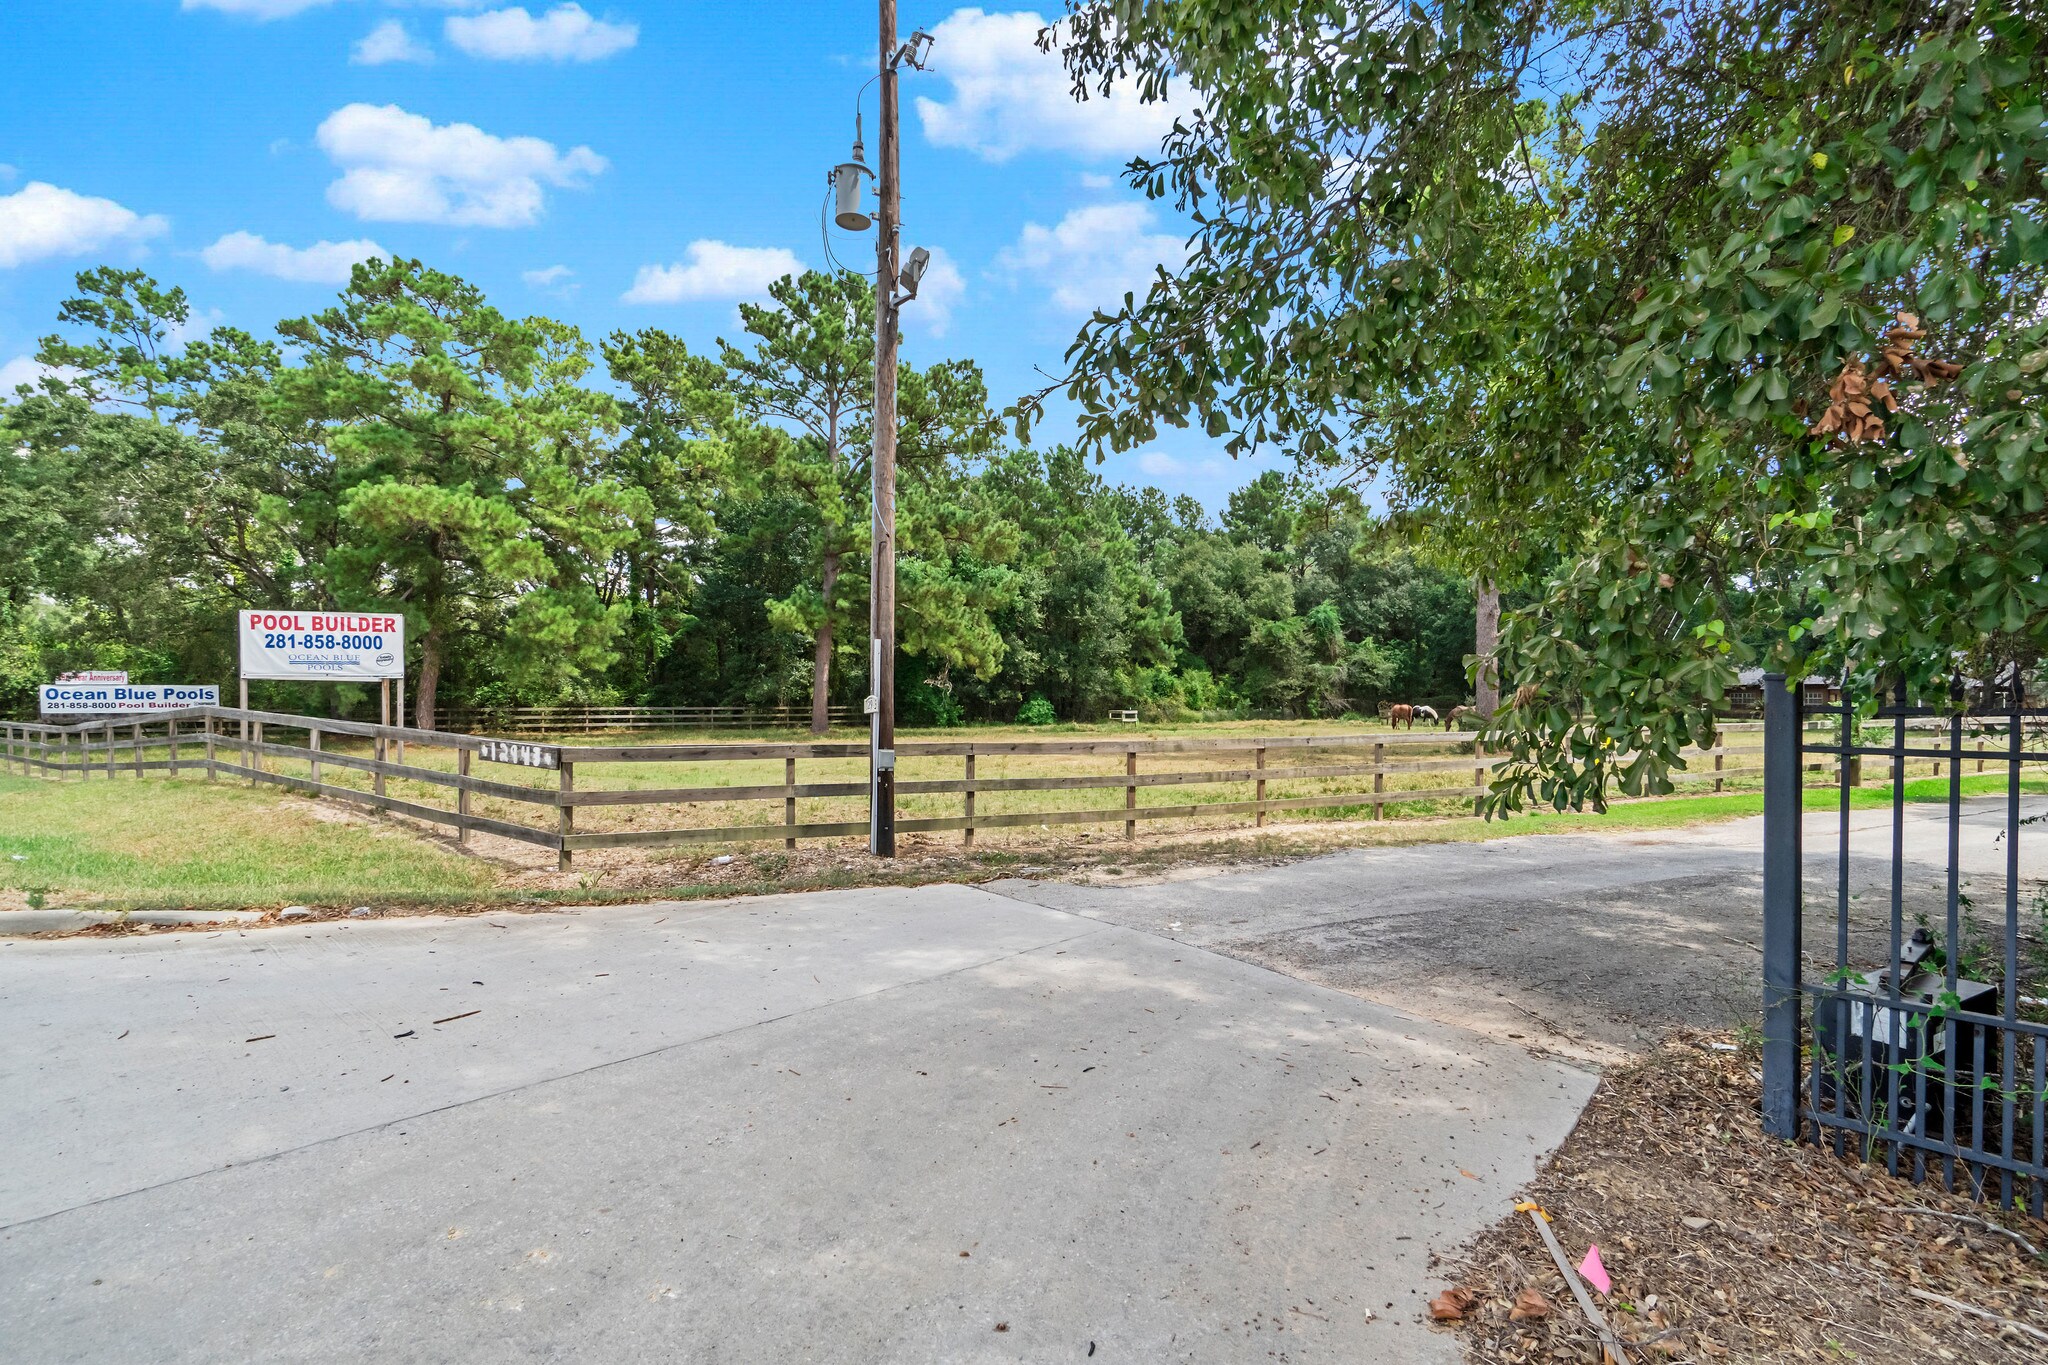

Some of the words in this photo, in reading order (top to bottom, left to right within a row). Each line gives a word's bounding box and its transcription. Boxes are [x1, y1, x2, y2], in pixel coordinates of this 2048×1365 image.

[250, 614, 304, 631] POOL
[312, 616, 396, 633] BUILDER
[265, 634, 383, 650] 281-858-8000
[89, 671, 125, 683] Anniversary
[45, 687, 107, 700] Ocean
[114, 687, 157, 700] Blue
[164, 688, 215, 700] Pools
